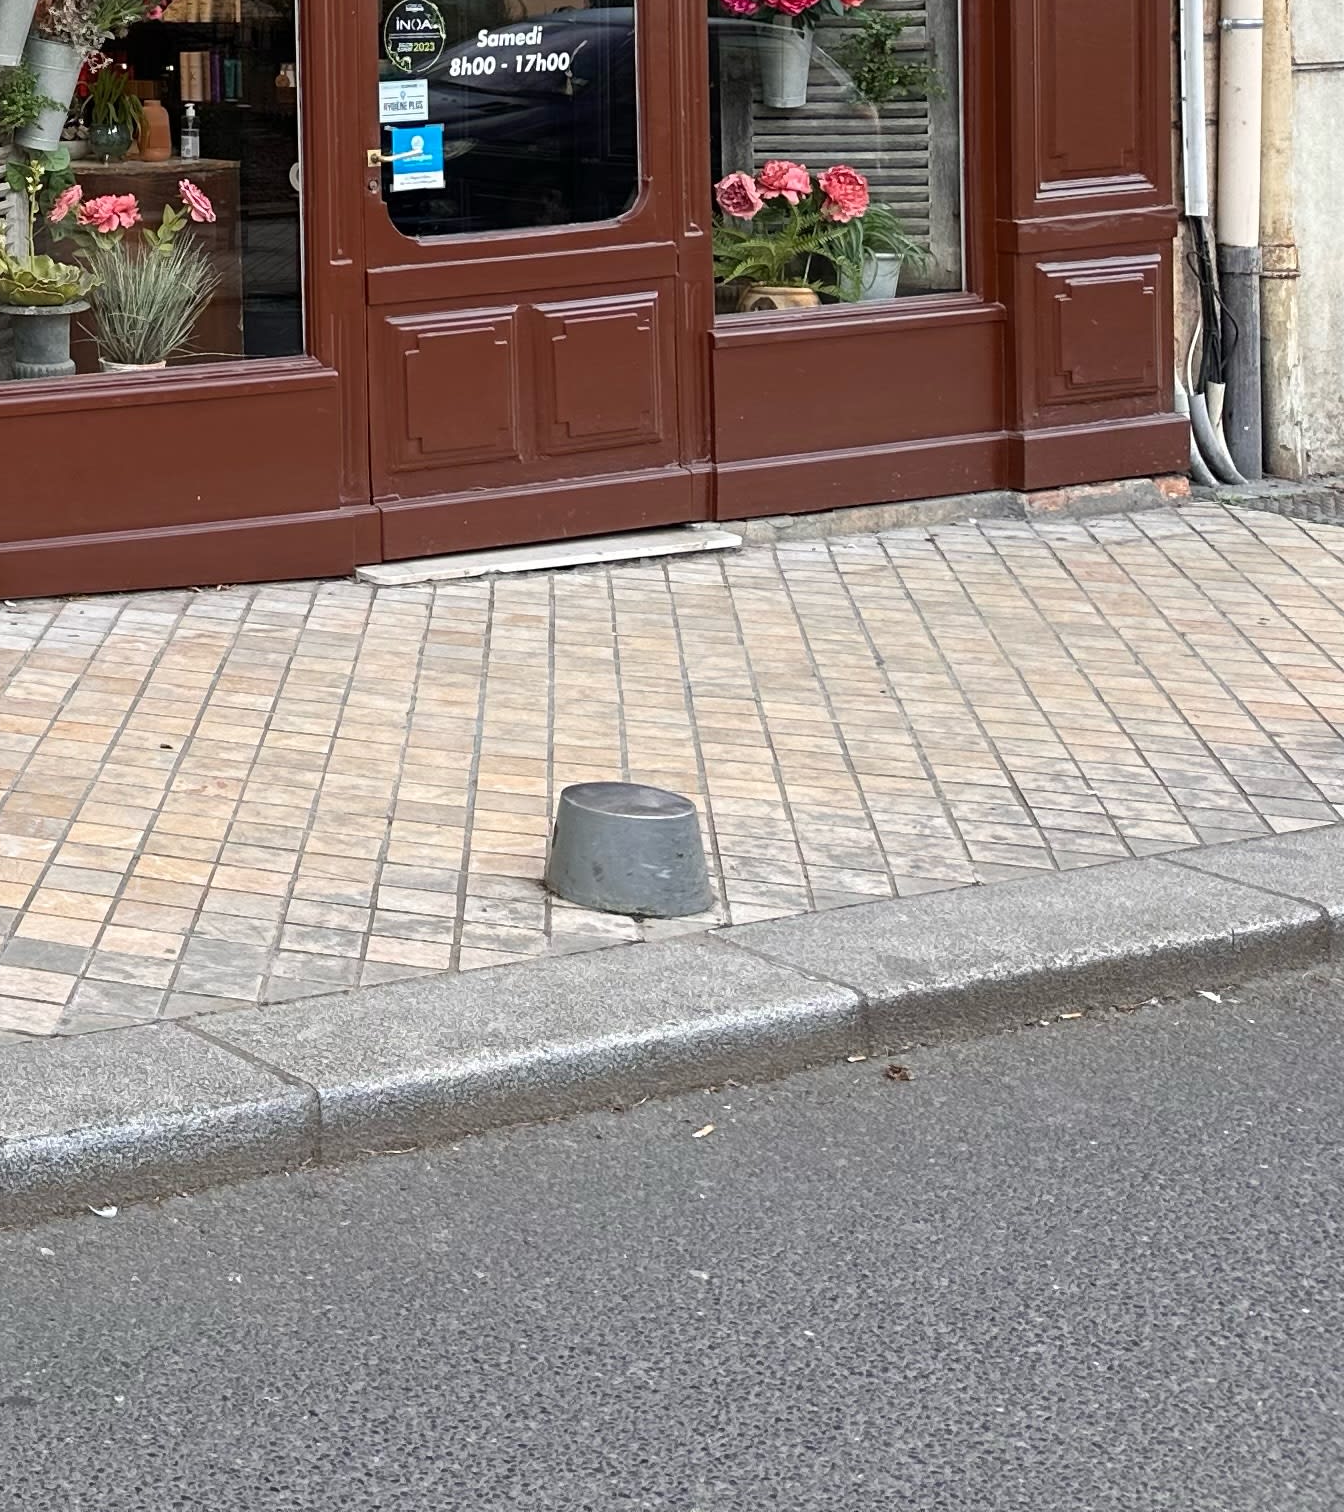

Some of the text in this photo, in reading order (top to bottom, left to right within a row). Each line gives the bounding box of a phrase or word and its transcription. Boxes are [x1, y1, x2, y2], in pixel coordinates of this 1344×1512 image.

[413, 42, 435, 52] 2023
[477, 26, 543, 48] Samedi
[449, 56, 497, 77] 8h00
[515, 53, 570, 73] 17h00
